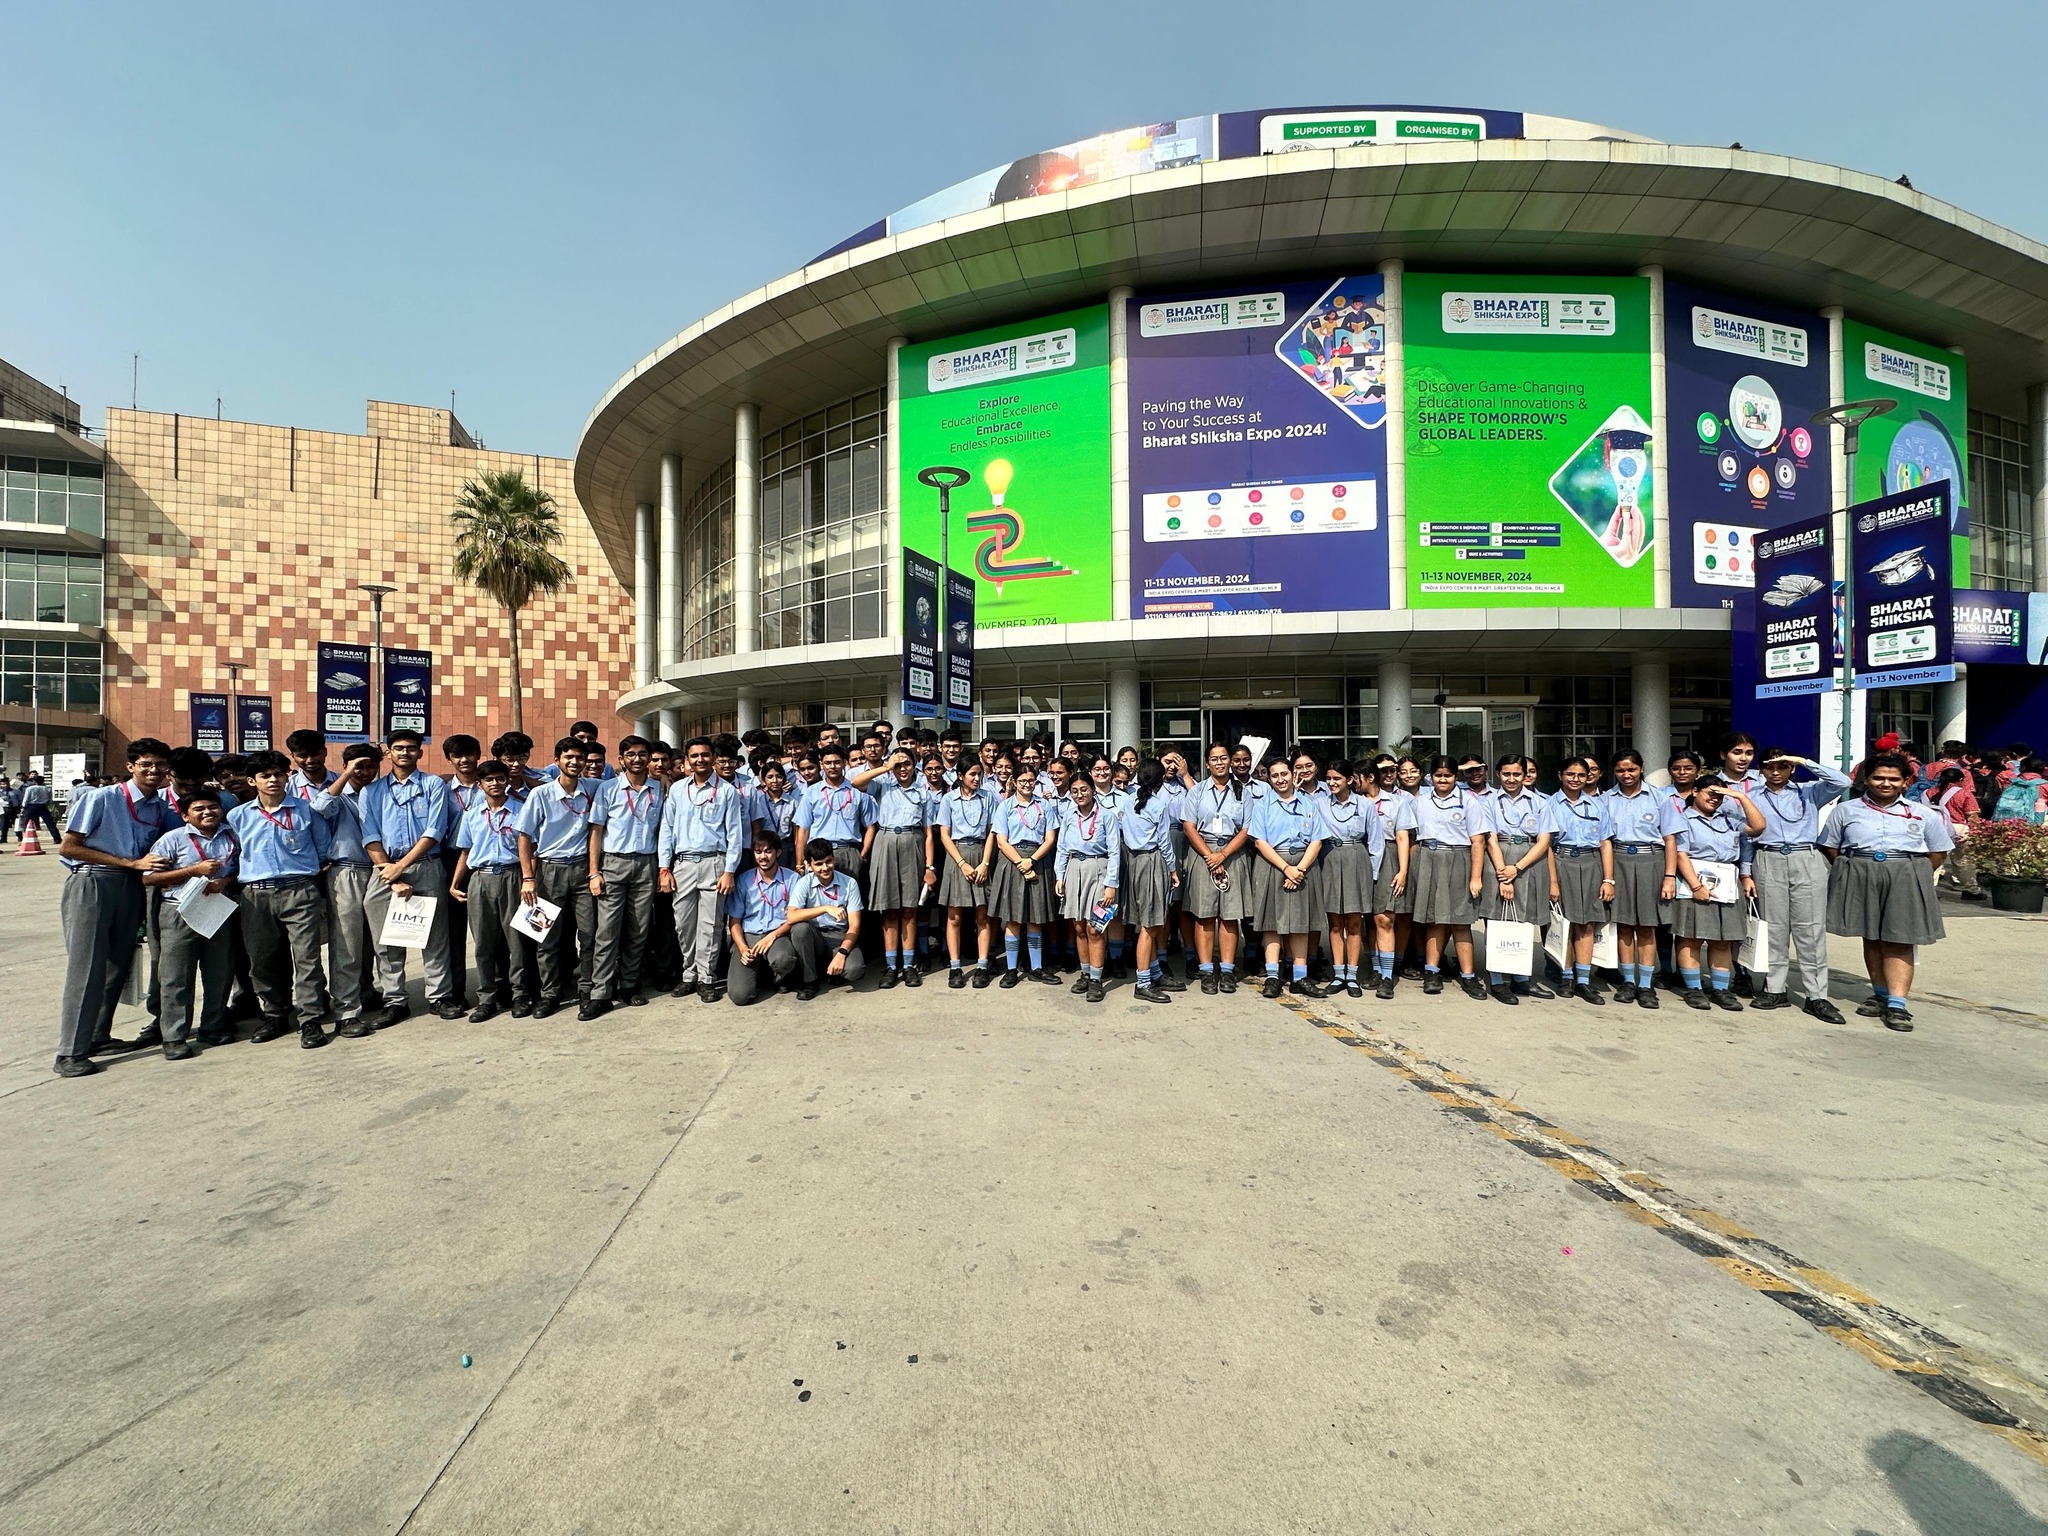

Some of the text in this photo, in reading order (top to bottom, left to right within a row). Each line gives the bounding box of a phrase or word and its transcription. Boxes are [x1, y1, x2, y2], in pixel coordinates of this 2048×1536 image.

[1294, 125, 1366, 136] SUPPORTED BY
[1404, 125, 1474, 136] ORGANISED BY
[1166, 304, 1220, 316] BHARAT
[1474, 300, 1540, 312] BHARAT
[1166, 313, 1220, 324] SHIKSHA EXPO
[1714, 318, 1758, 336] BHARAT
[1714, 329, 1742, 341] SHIKSHA
[1742, 334, 1759, 344] EXPO
[953, 348, 1009, 368] BHARAT
[1880, 352, 1914, 371] BHARAT
[954, 362, 986, 374] SHIKSHA
[988, 358, 1009, 368] EXPO
[1881, 364, 1902, 376] SHIKSHA
[1902, 369, 1914, 379] EXPO
[1418, 380, 1585, 397] Discover Game-Changing
[979, 394, 1020, 410] Explore
[1142, 395, 1244, 415] Paving the Way
[1418, 396, 1588, 410] Educational Innovations &
[941, 401, 1061, 430] Educational Excellence,
[1142, 411, 1262, 432] to Your Success at
[1418, 412, 1568, 425] SHAPE TOMORROW'S
[976, 420, 1023, 436] Embrace
[1418, 428, 1548, 441] GLOBAL LEADERS.
[950, 428, 1052, 454] Endless Possibilities
[1142, 423, 1327, 449] Bharat Shiksha Expo 2024!
[1878, 498, 1934, 521] BHARAT
[1878, 506, 1934, 526] SHIKSHA EXPO
[1773, 529, 1818, 548] BHARAT
[1774, 538, 1818, 553] SHIKSHA EXPO
[914, 564, 934, 578] BHARAT
[1420, 572, 1532, 582] 11-13 NOVEMBER, 2024
[1144, 574, 1250, 588] 11-13 NOVEMBER, 2024
[1721, 599, 1734, 609] 11-1
[1870, 595, 1934, 617] BHARAT
[1870, 610, 1934, 628] SHIKSHA
[1952, 606, 2012, 624] BHARAT
[976, 619, 1026, 630] OVEMBER
[1766, 616, 1817, 634] BHARAT
[1954, 624, 2012, 634] HIKSHA EXPO
[1766, 628, 1817, 644] SHIKSHA
[910, 642, 934, 657] BHARAT
[910, 653, 934, 667] SHIKSHA
[952, 654, 970, 667] BHARAT
[952, 664, 970, 677] SHIKSHA
[1865, 670, 1940, 684] 11-13 November
[1764, 682, 1824, 694] 11-13 November
[326, 698, 362, 706] BHARAT
[326, 704, 362, 712] SHIKSHA
[392, 912, 428, 924] IIMT
[1500, 940, 1521, 948] IIMT
